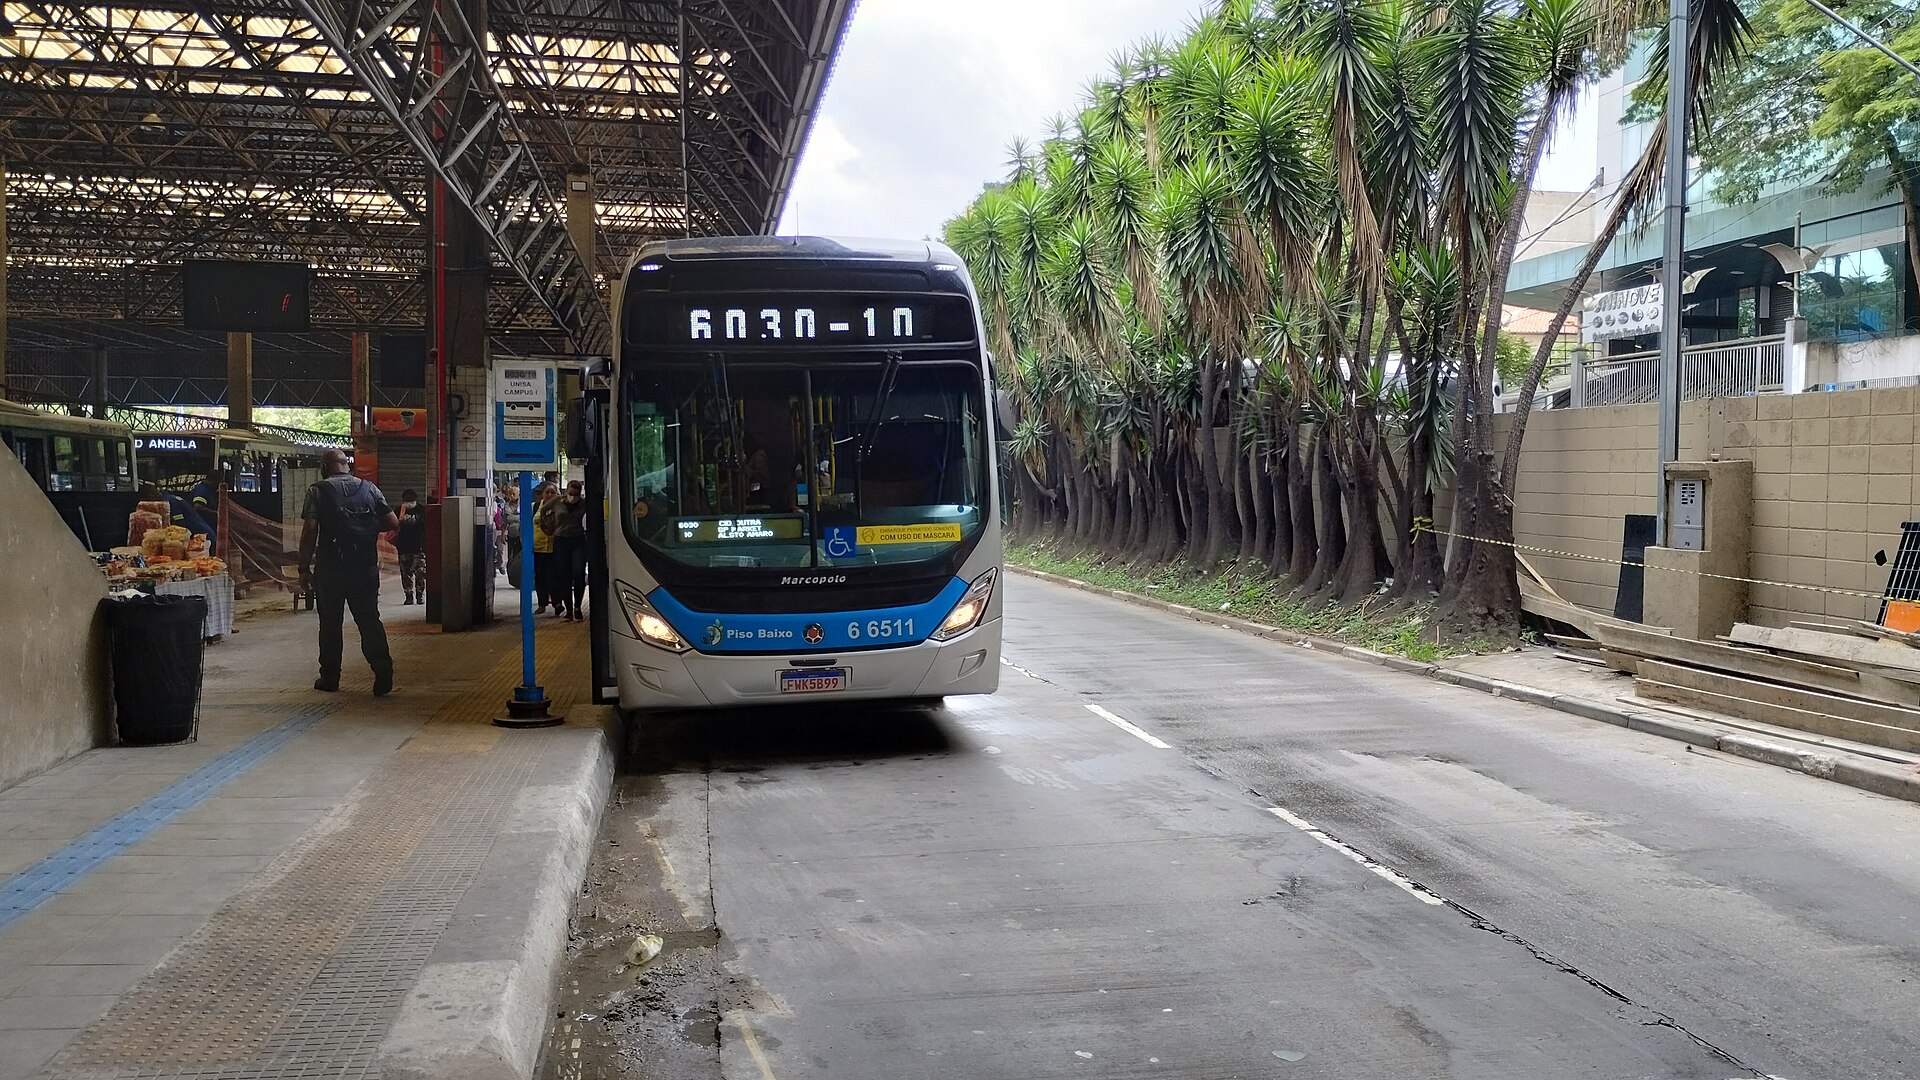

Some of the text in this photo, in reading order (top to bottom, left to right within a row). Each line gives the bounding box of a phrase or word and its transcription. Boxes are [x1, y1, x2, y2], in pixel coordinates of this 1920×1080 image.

[149, 438, 197, 449] ANGELA
[781, 575, 846, 586] Marcopolo
[727, 628, 793, 639] Piso Baixo
[847, 618, 914, 639] 6 6511
[787, 677, 839, 691] FWK5B99
